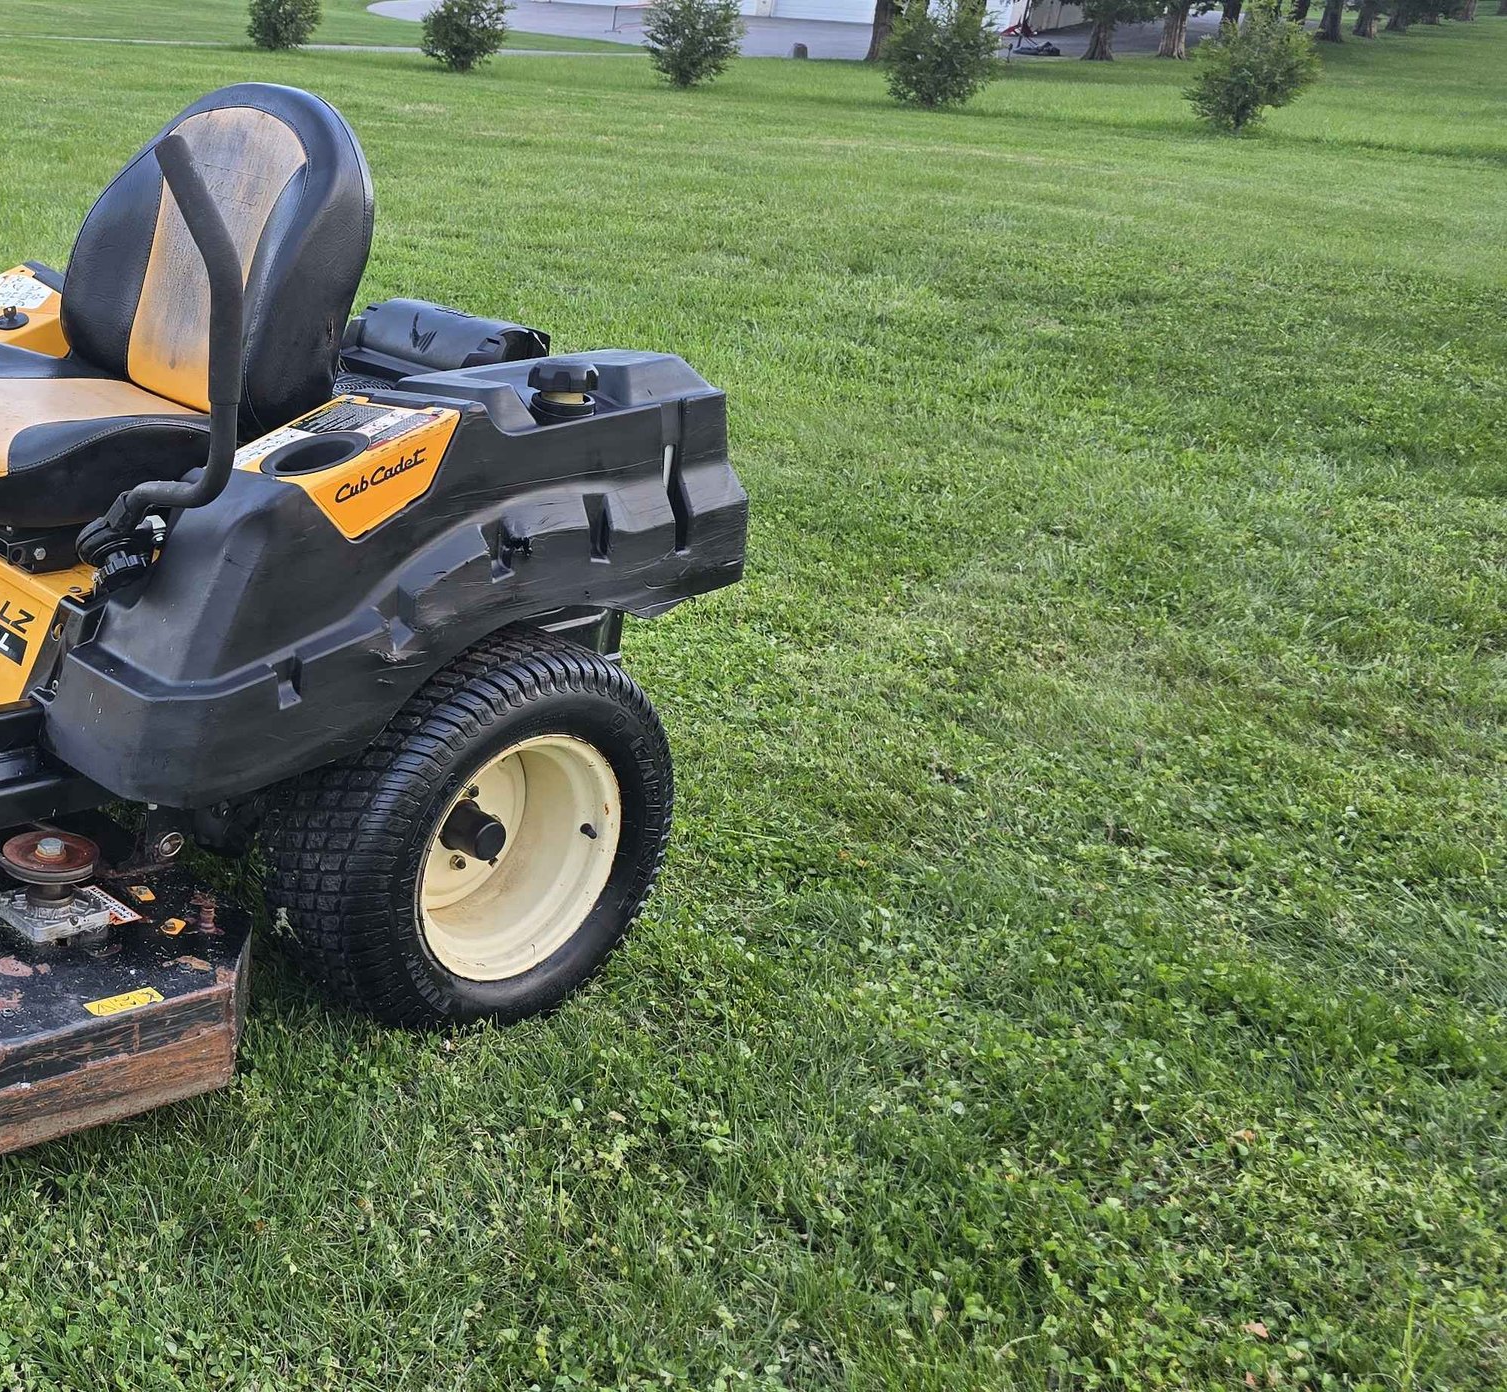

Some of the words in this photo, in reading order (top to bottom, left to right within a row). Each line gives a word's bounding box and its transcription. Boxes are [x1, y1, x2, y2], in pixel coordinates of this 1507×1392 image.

[335, 475, 369, 503] Cub
[370, 447, 426, 486] Cadet
[400, 952, 454, 1015] TURF
